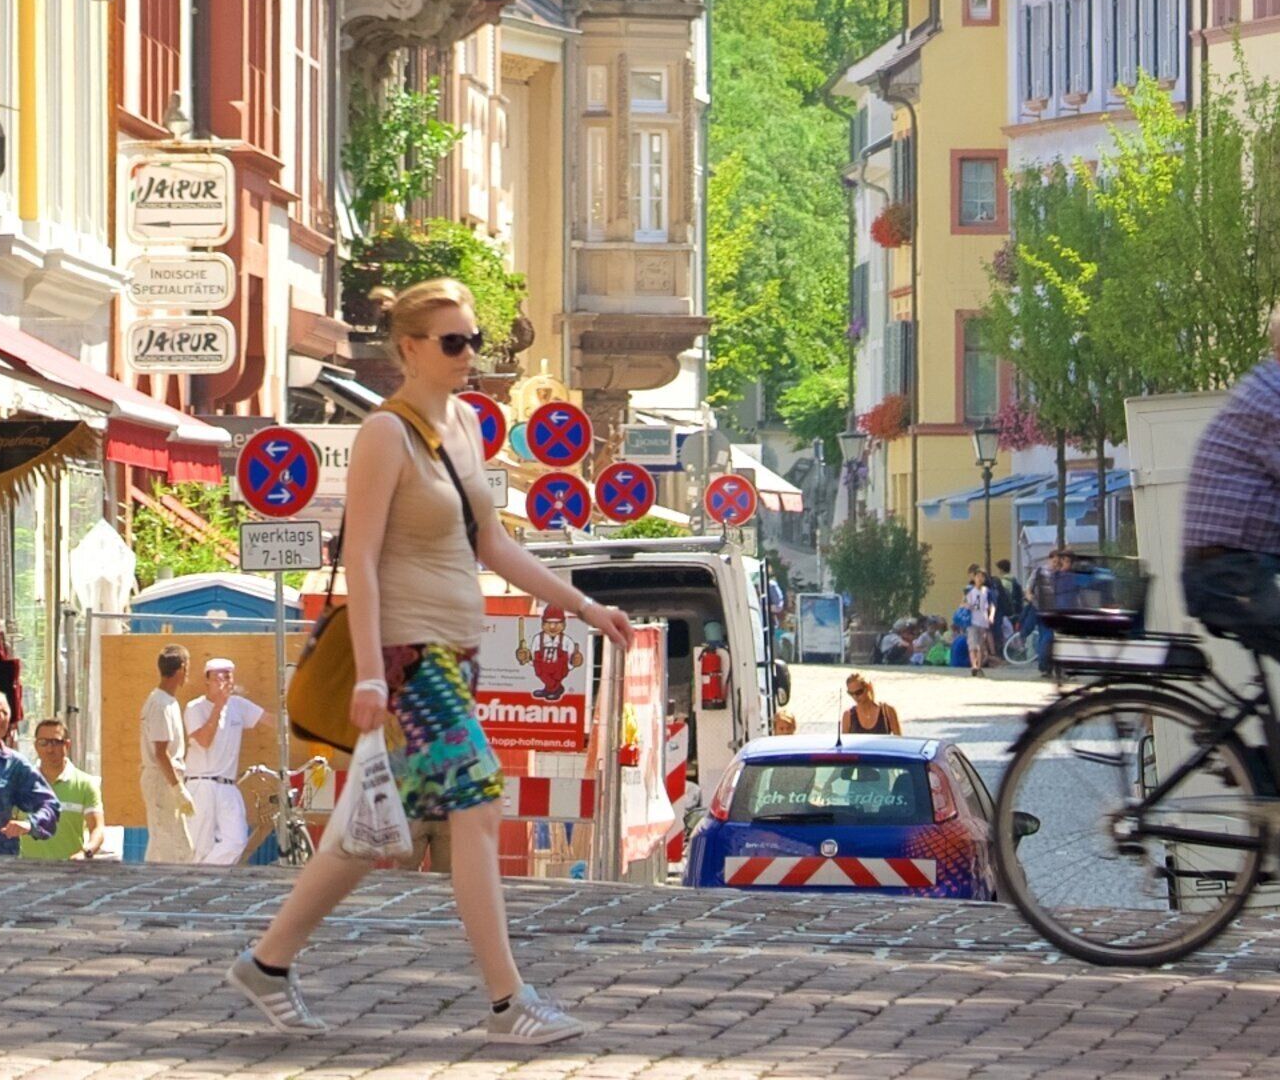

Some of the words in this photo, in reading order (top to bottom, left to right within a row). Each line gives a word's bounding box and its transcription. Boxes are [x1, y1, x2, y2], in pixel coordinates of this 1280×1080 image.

[136, 176, 219, 203] JAIPUR
[150, 268, 207, 280] INDISCHE
[132, 282, 225, 296] SPEZIALITÄTEN
[136, 330, 219, 357] JAIPUR
[248, 527, 314, 546] werktags
[262, 549, 302, 566] 7-18h
[475, 698, 577, 724] ofmann
[488, 736, 576, 748] .hopp-hofmann.de
